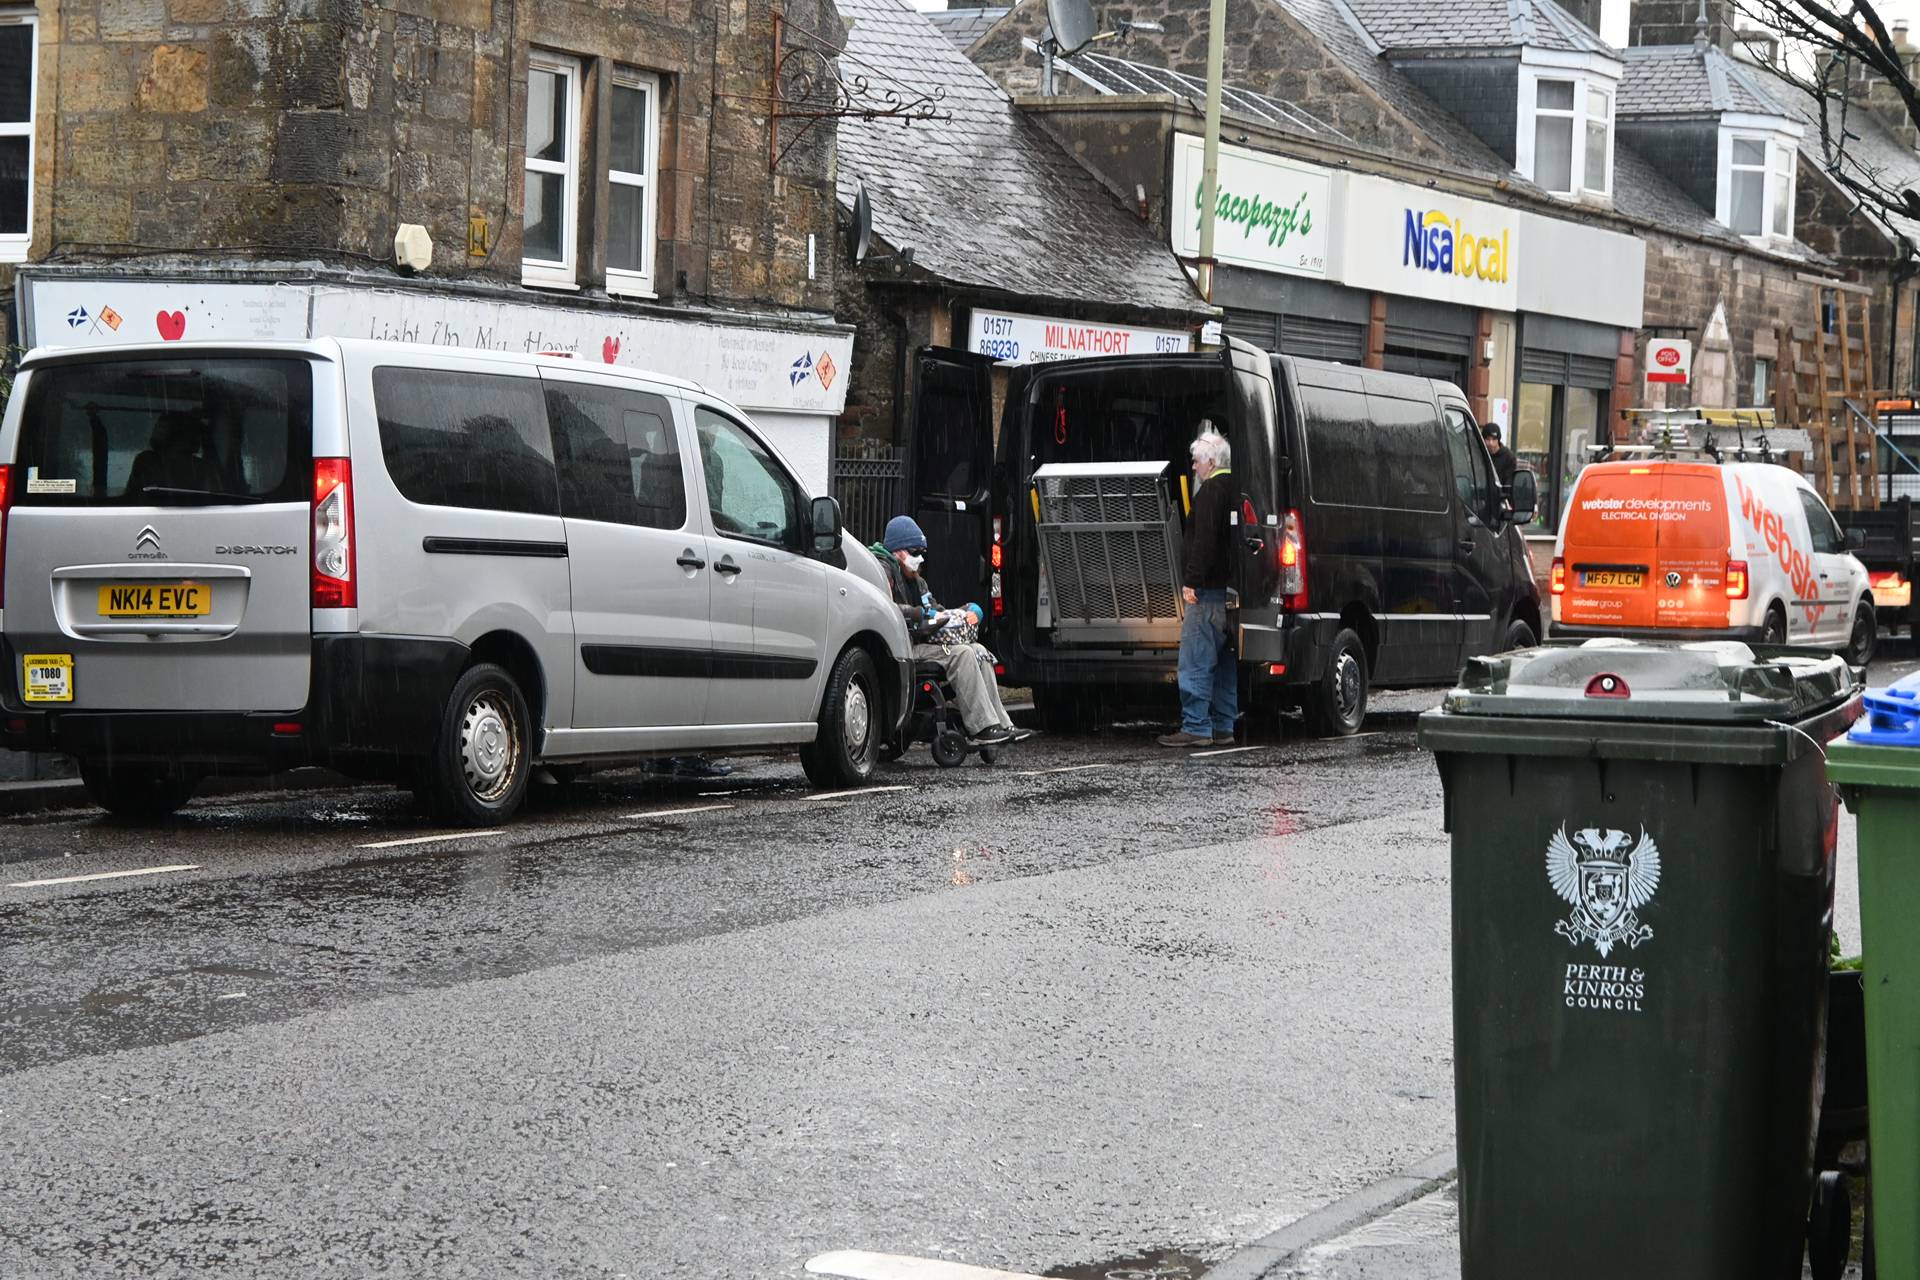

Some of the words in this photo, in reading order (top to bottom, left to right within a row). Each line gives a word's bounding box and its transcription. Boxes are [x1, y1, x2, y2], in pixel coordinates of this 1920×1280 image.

[1403, 208, 1453, 274] Nisa
[1454, 218, 1509, 284] local
[983, 316, 1014, 337] 01577
[1045, 324, 1130, 355] MILNATHORT
[1155, 335, 1181, 353] 01577
[980, 339, 1020, 360] 869230
[1582, 498, 1624, 511] webster
[1625, 498, 1712, 512] developments
[1601, 511, 1648, 521] ELECTRICAL
[1649, 511, 1686, 521] DIVISION
[215, 544, 298, 555] DISPATCH
[1586, 573, 1616, 585] MF67
[1618, 573, 1641, 585] LCM
[110, 588, 154, 611] NK14
[159, 588, 199, 611] EVC
[39, 667, 61, 679] T080
[1565, 964, 1627, 981] PERTH
[1630, 967, 1645, 982] &
[1563, 980, 1645, 999] KINROSS
[1565, 996, 1642, 1012] COUNCIL
